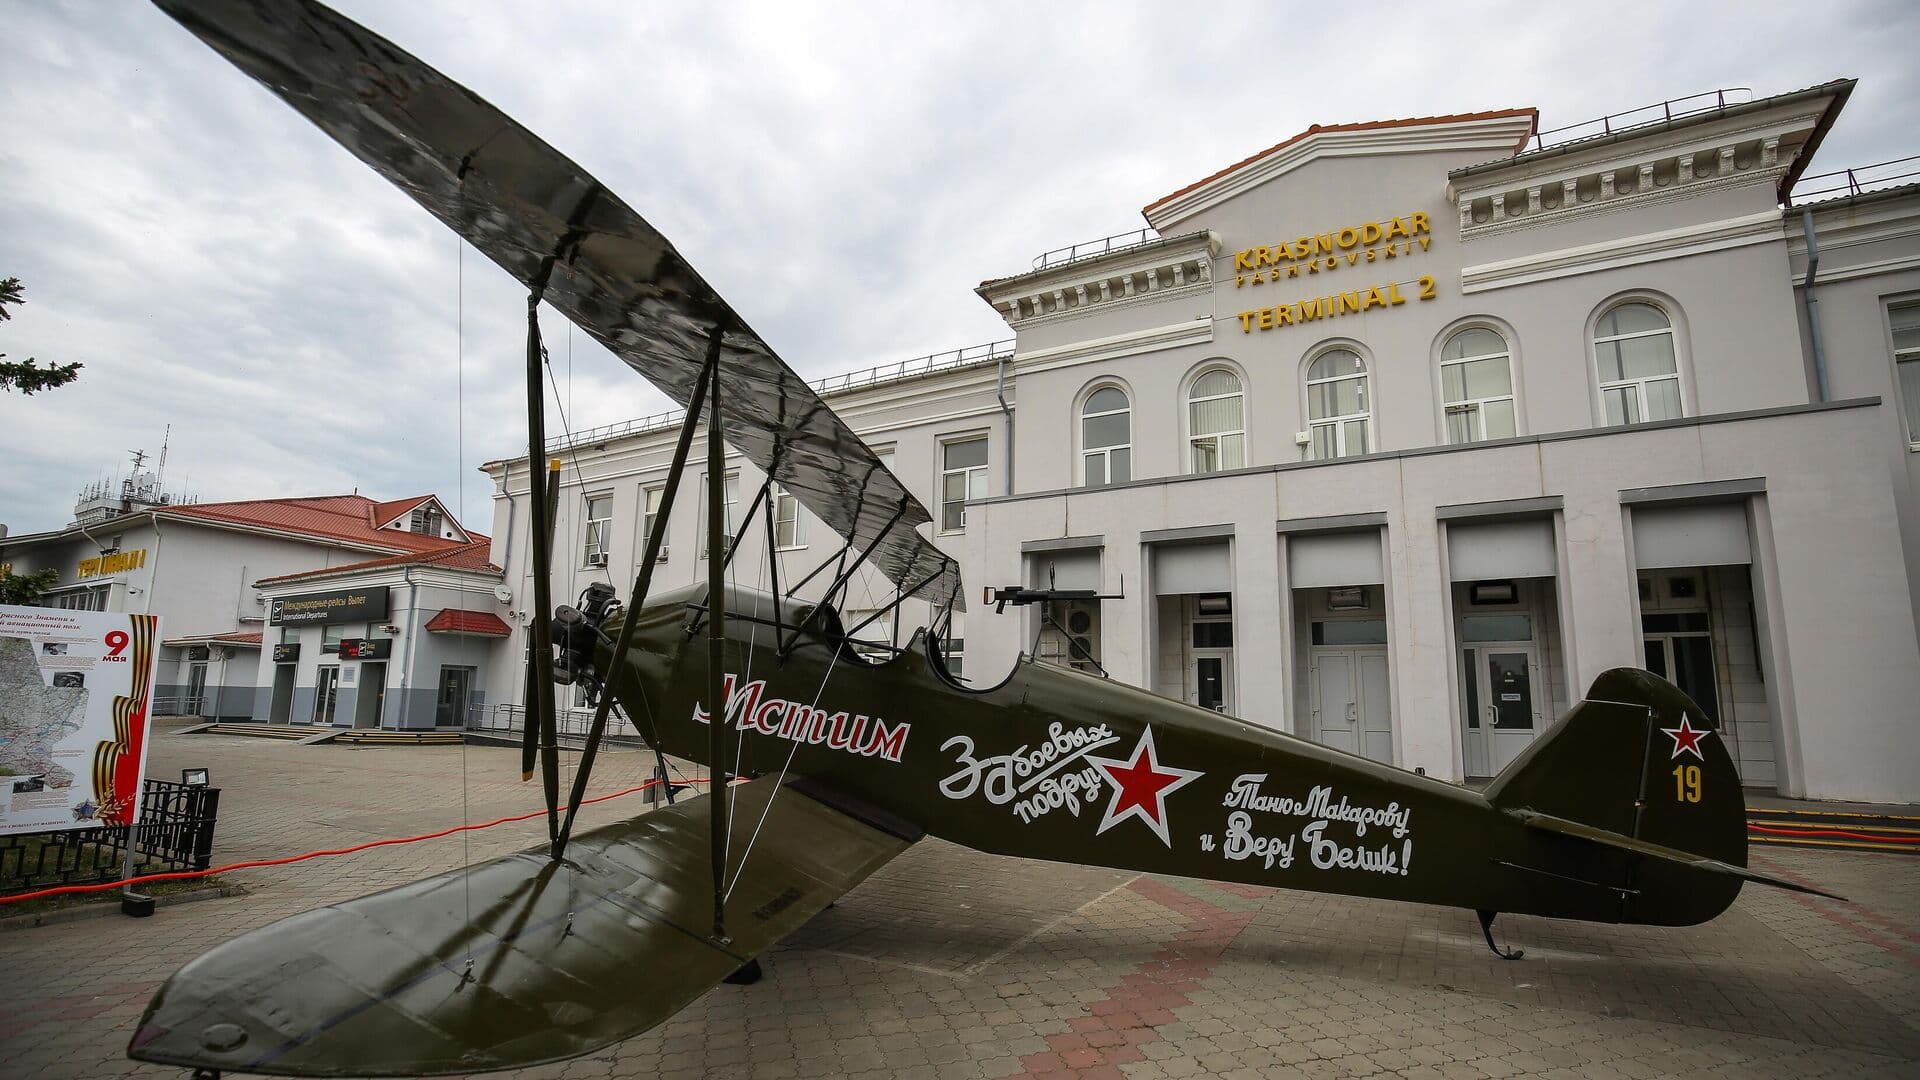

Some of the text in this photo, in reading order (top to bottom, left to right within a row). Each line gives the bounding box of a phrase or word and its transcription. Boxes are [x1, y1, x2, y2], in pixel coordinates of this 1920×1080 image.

[1234, 210, 1431, 273] KRASNODAR
[1235, 236, 1432, 289] PASHKOVSKIY
[1238, 274, 1437, 334] TERMINAL 2
[0, 612, 33, 620] расного
[283, 612, 307, 621] International
[307, 611, 329, 620] Departures
[348, 595, 367, 605] Вылет
[105, 630, 129, 656] 9
[692, 673, 911, 762] Мстим
[939, 735, 1017, 804] За
[1012, 721, 1113, 777] боевых
[1013, 767, 1102, 824] подруг
[1222, 773, 1410, 838] Таню Макарову
[1672, 764, 1702, 803] 19
[1200, 811, 1413, 876] и Веру Белик!
